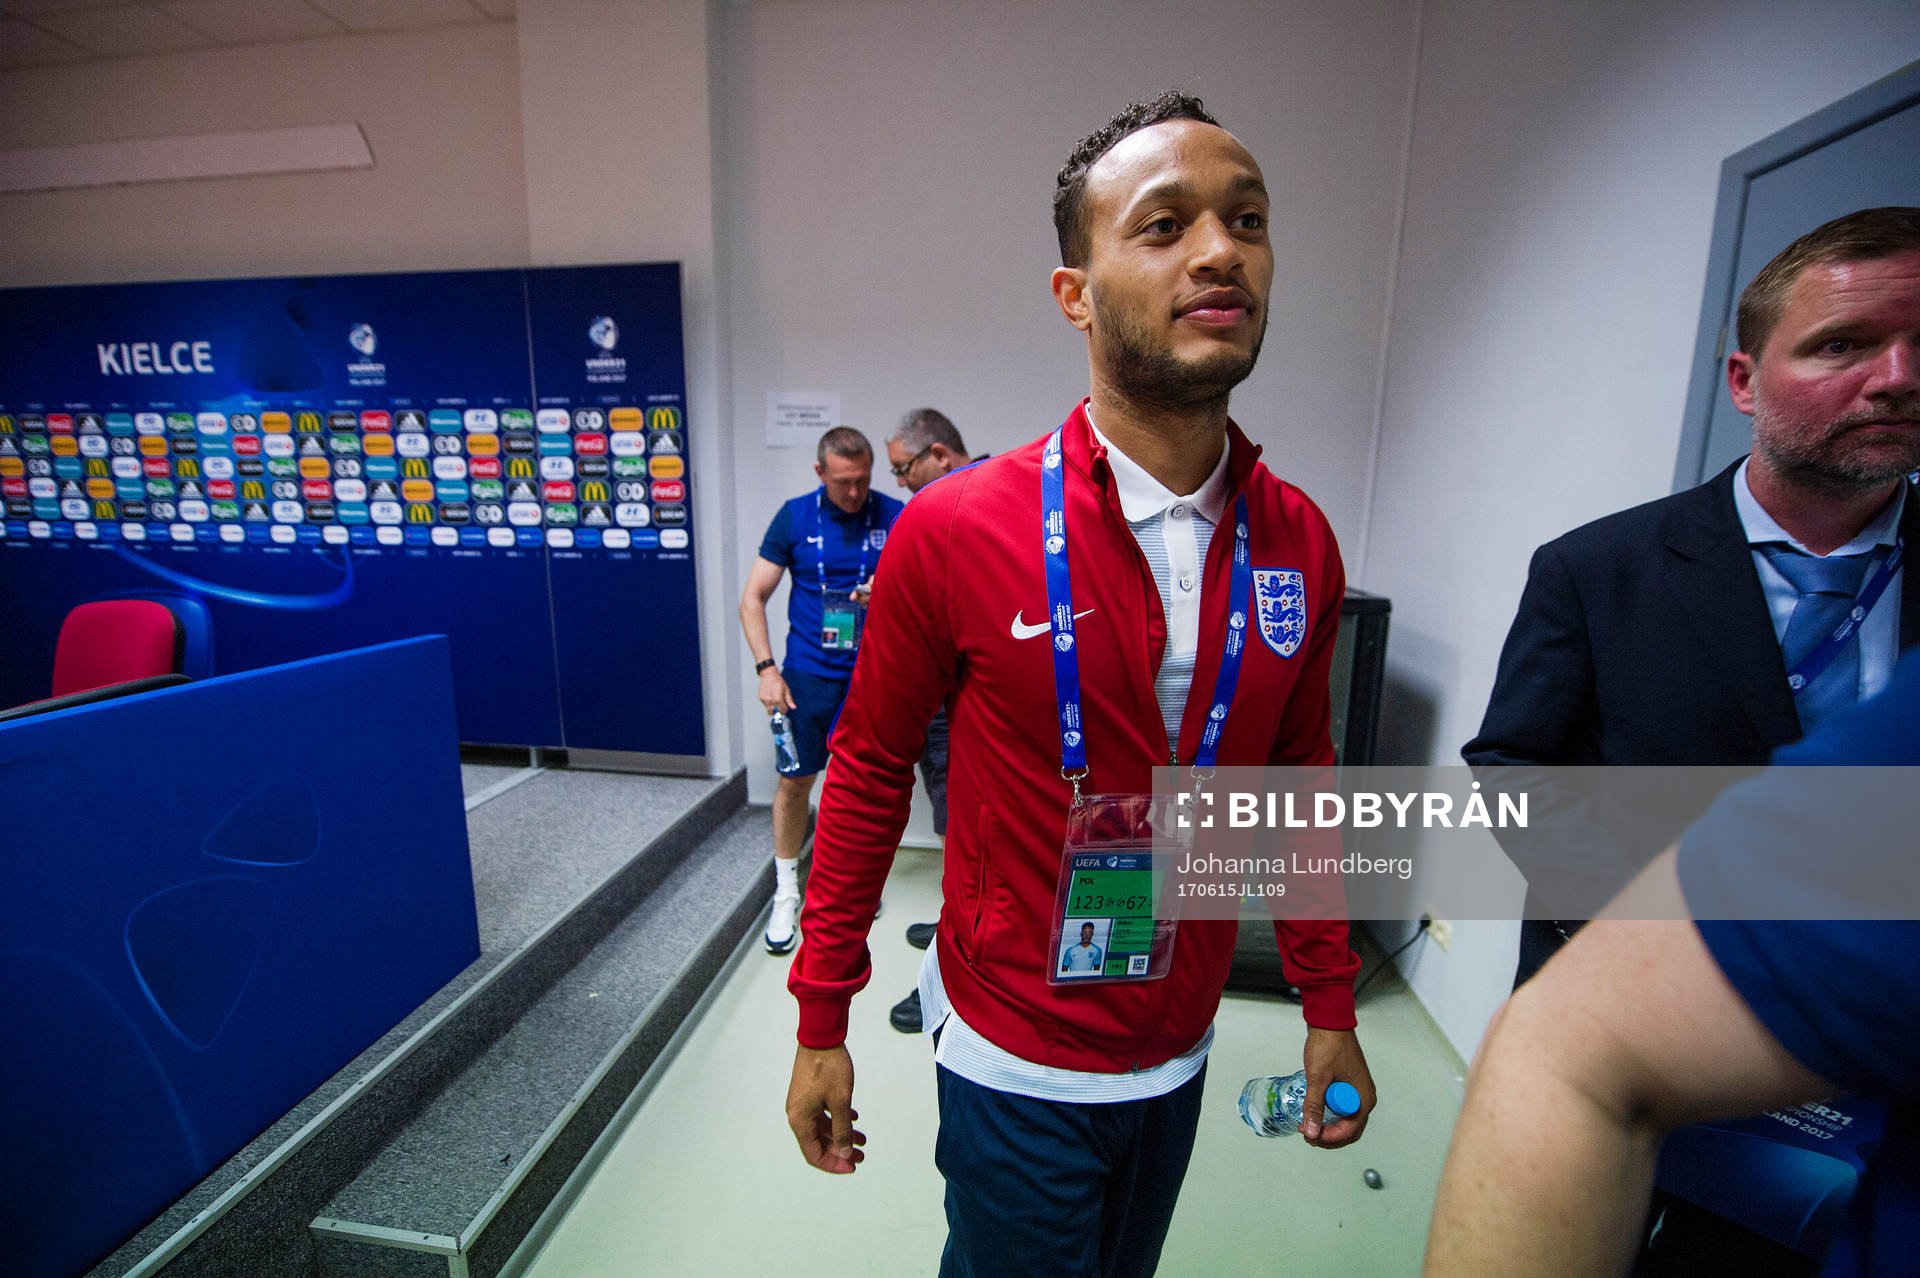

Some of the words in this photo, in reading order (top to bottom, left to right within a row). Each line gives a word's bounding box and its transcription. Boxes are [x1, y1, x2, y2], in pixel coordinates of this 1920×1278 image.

[97, 341, 215, 376] KIELCE
[1075, 858, 1101, 867] UEFA
[1080, 877, 1095, 885] POL
[1801, 1101, 1854, 1126] ER21
[1800, 1123, 1834, 1140] 2017
